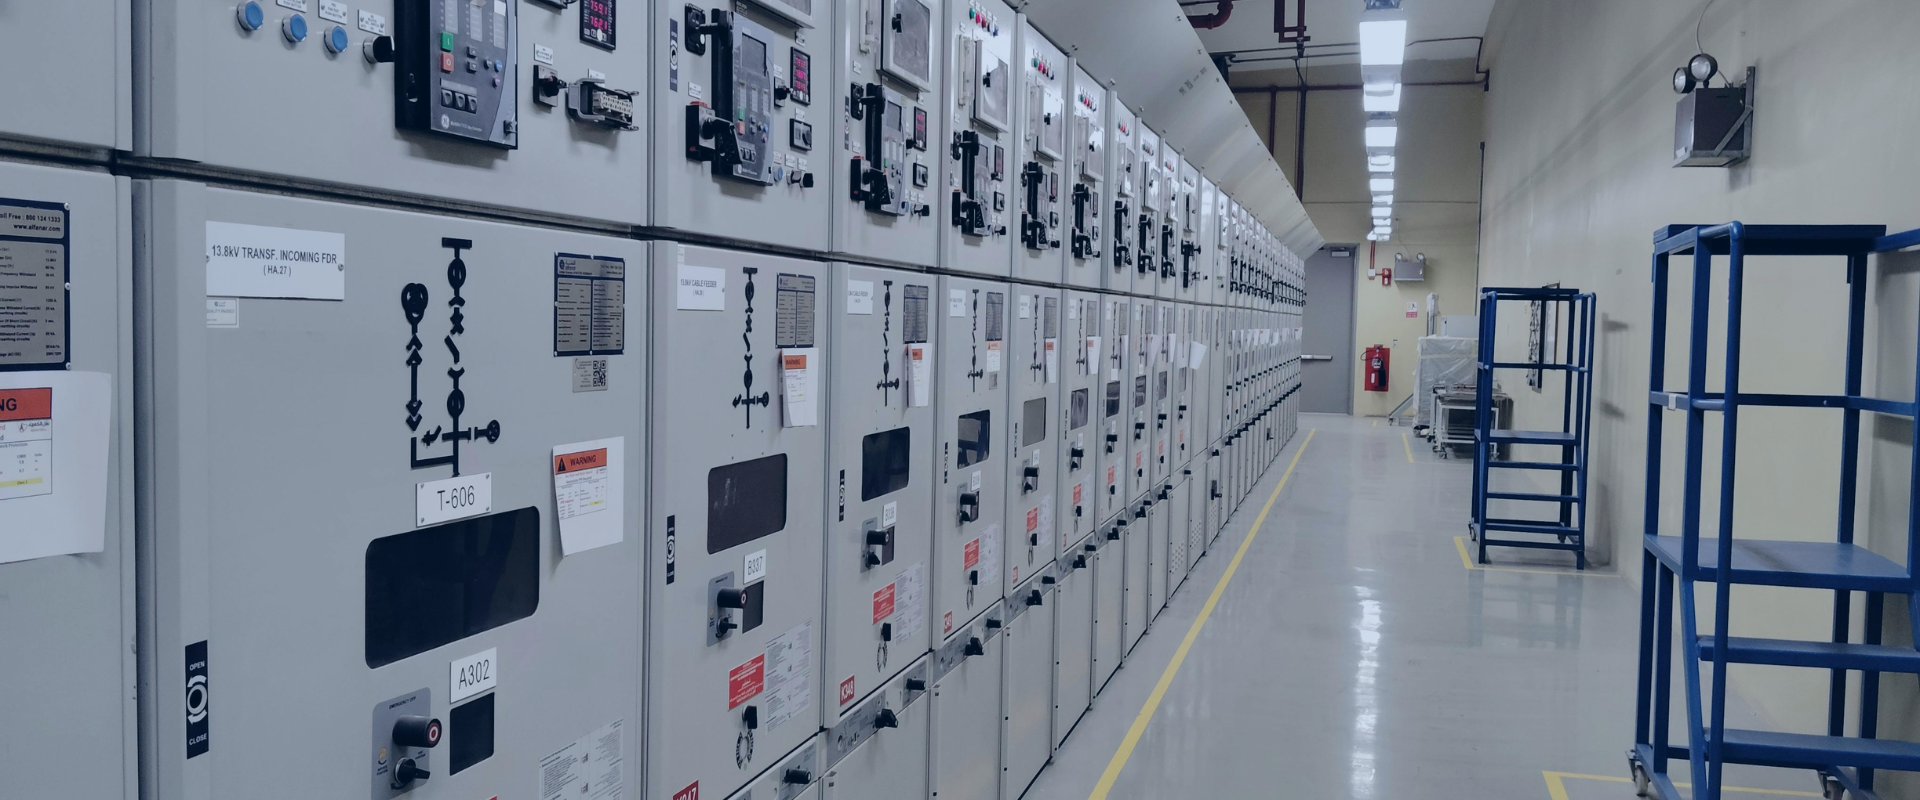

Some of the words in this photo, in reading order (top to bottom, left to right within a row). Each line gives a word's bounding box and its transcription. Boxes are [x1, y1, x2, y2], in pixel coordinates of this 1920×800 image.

[13, 224, 61, 232] www.alfanar.com
[211, 245, 240, 258] 13.8kV
[242, 247, 278, 261] TRANSF.
[280, 249, 320, 263] INCOMING
[321, 253, 337, 264] FDR
[267, 266, 287, 275] HA.27
[569, 454, 597, 467] WARNING
[436, 485, 476, 511] T-606
[747, 556, 763, 576] B337
[189, 660, 205, 671] OPEN
[458, 659, 490, 690] A302
[388, 699, 409, 710] EMERGENCY
[188, 732, 207, 746] CLOSE
